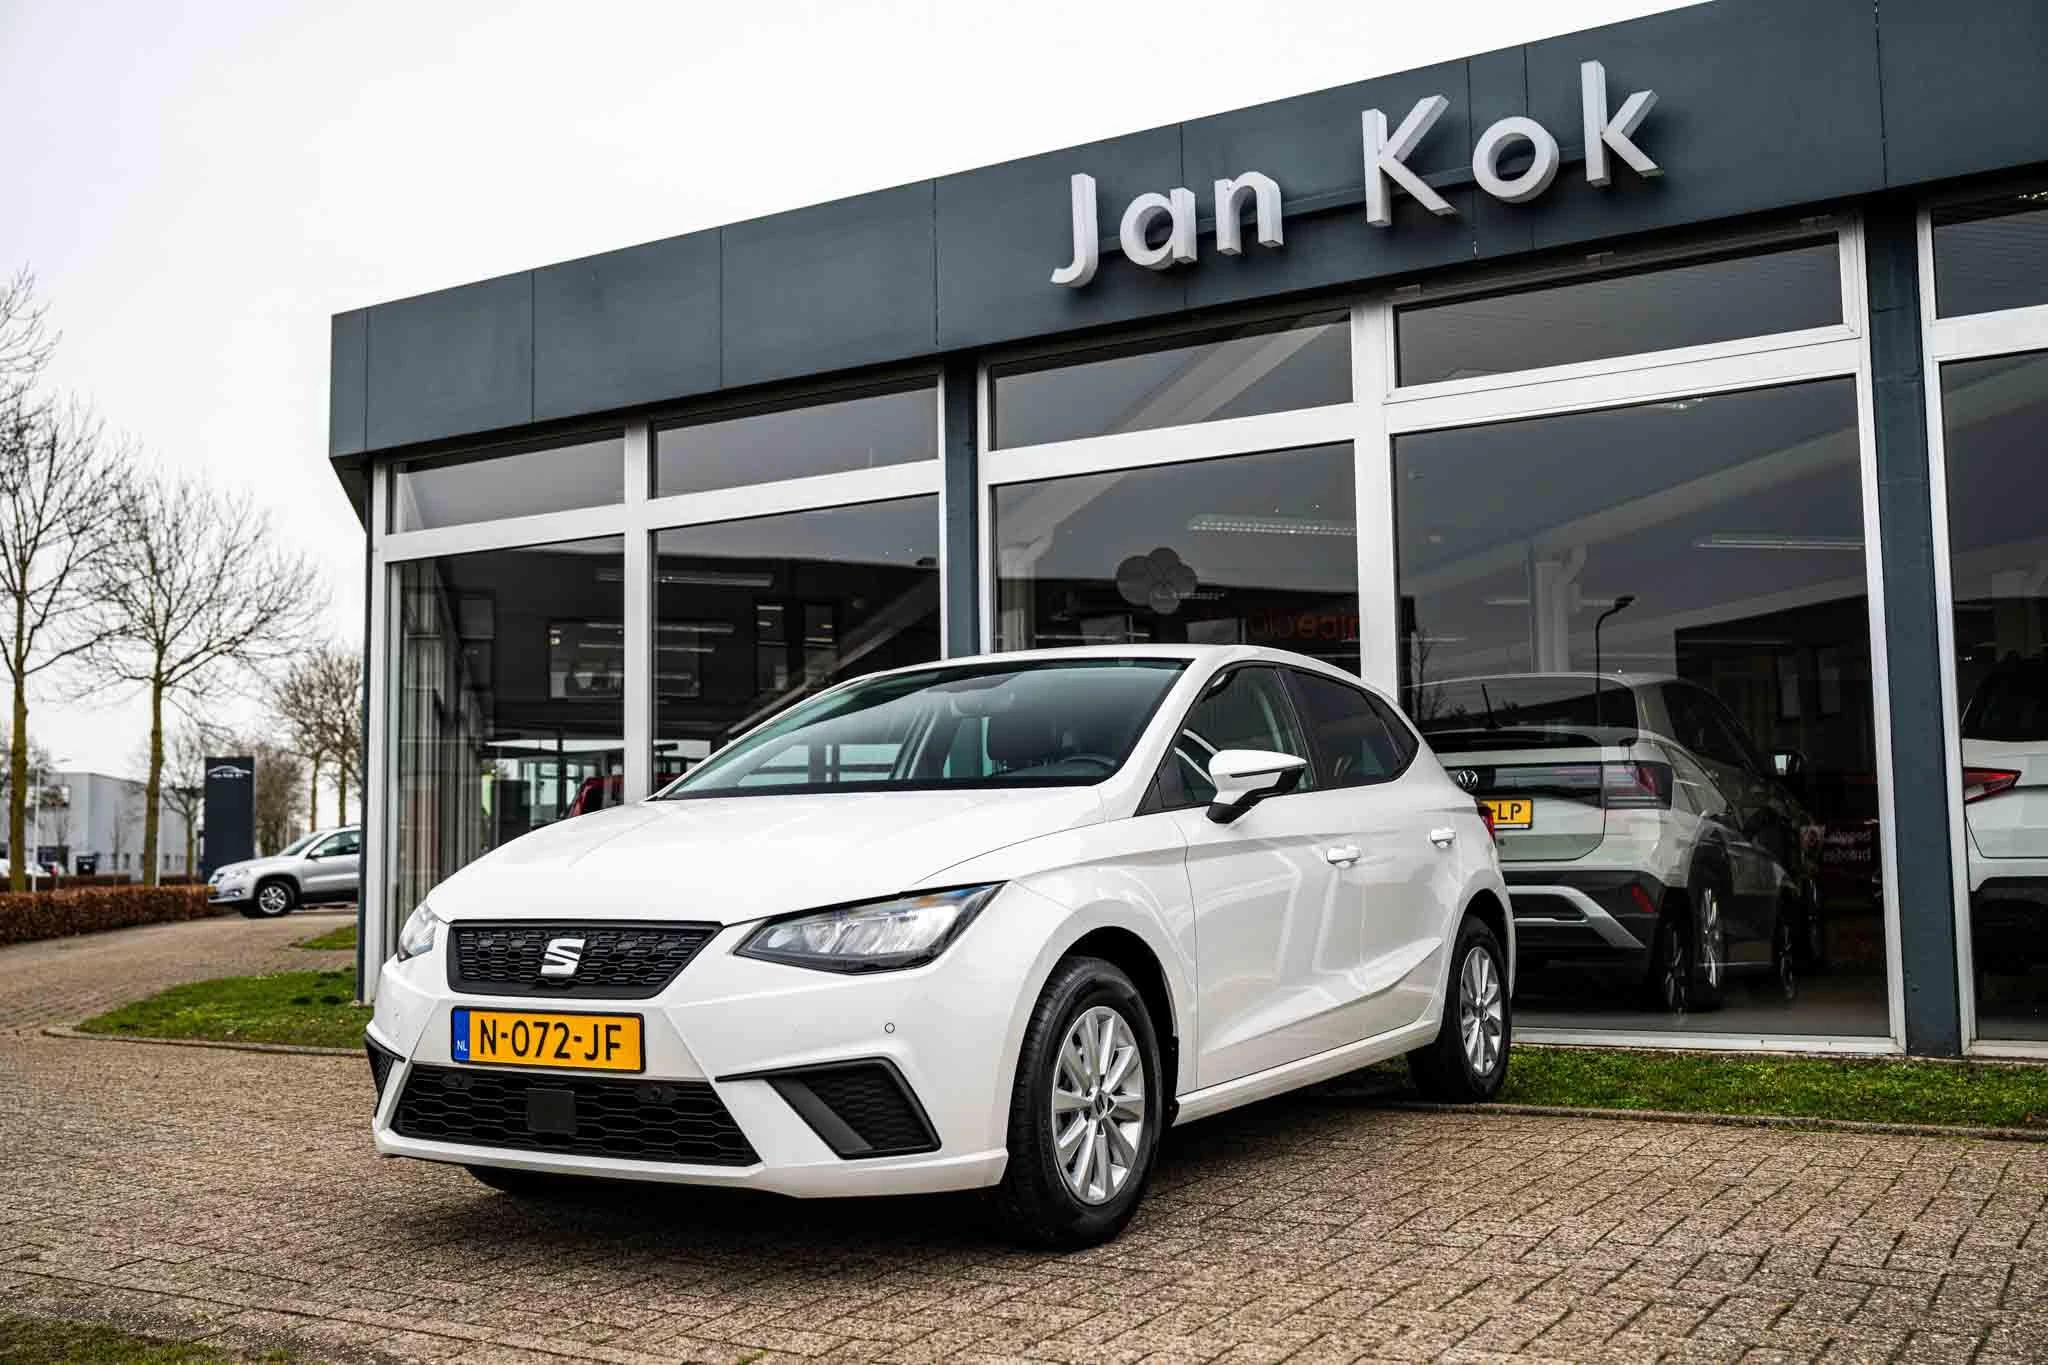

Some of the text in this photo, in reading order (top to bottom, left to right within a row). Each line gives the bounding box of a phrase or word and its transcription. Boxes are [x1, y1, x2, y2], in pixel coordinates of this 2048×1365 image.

[1050, 60, 1665, 288] Jan Kok
[456, 1039, 469, 1052] NL
[479, 1019, 623, 1062] N-072-JF
